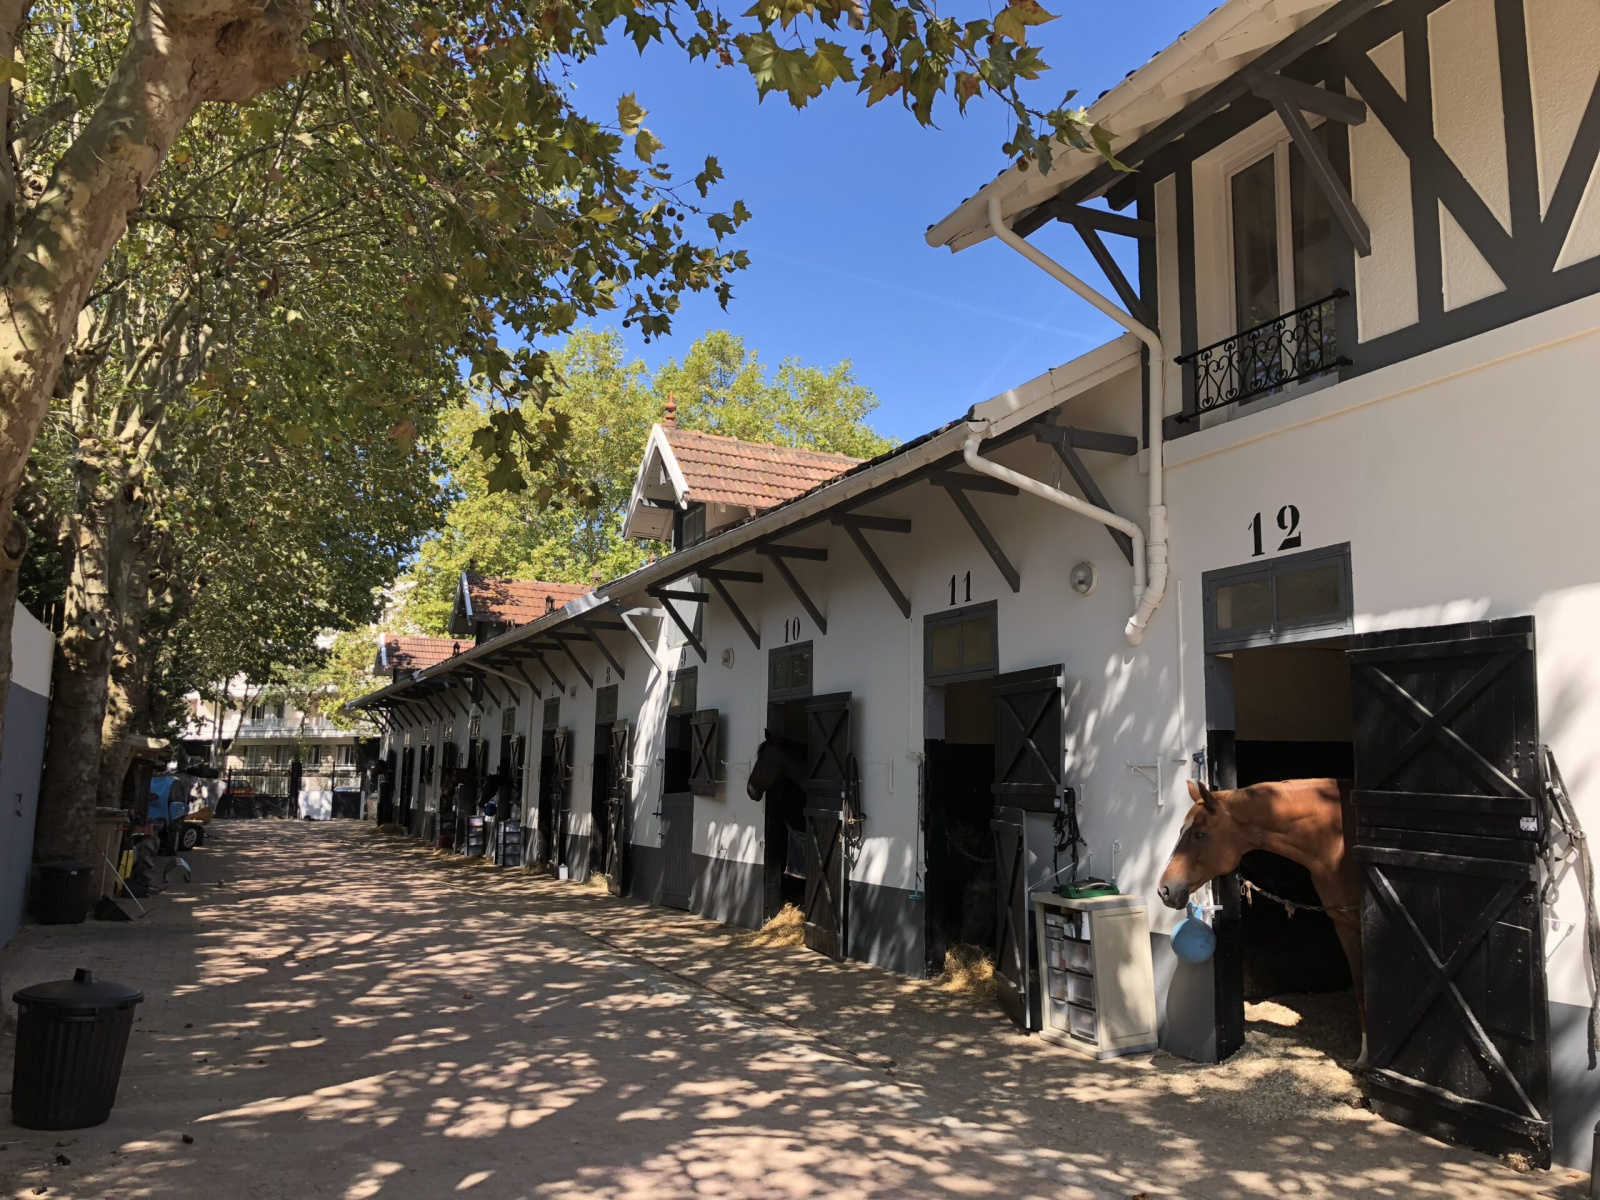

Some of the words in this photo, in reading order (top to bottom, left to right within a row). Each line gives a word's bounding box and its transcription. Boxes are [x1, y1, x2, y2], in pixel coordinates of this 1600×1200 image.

[1247, 504, 1302, 557] 12
[948, 570, 972, 606] 11
[784, 616, 801, 643] 10
[680, 647, 687, 667] 9
[605, 666, 611, 684] 8
